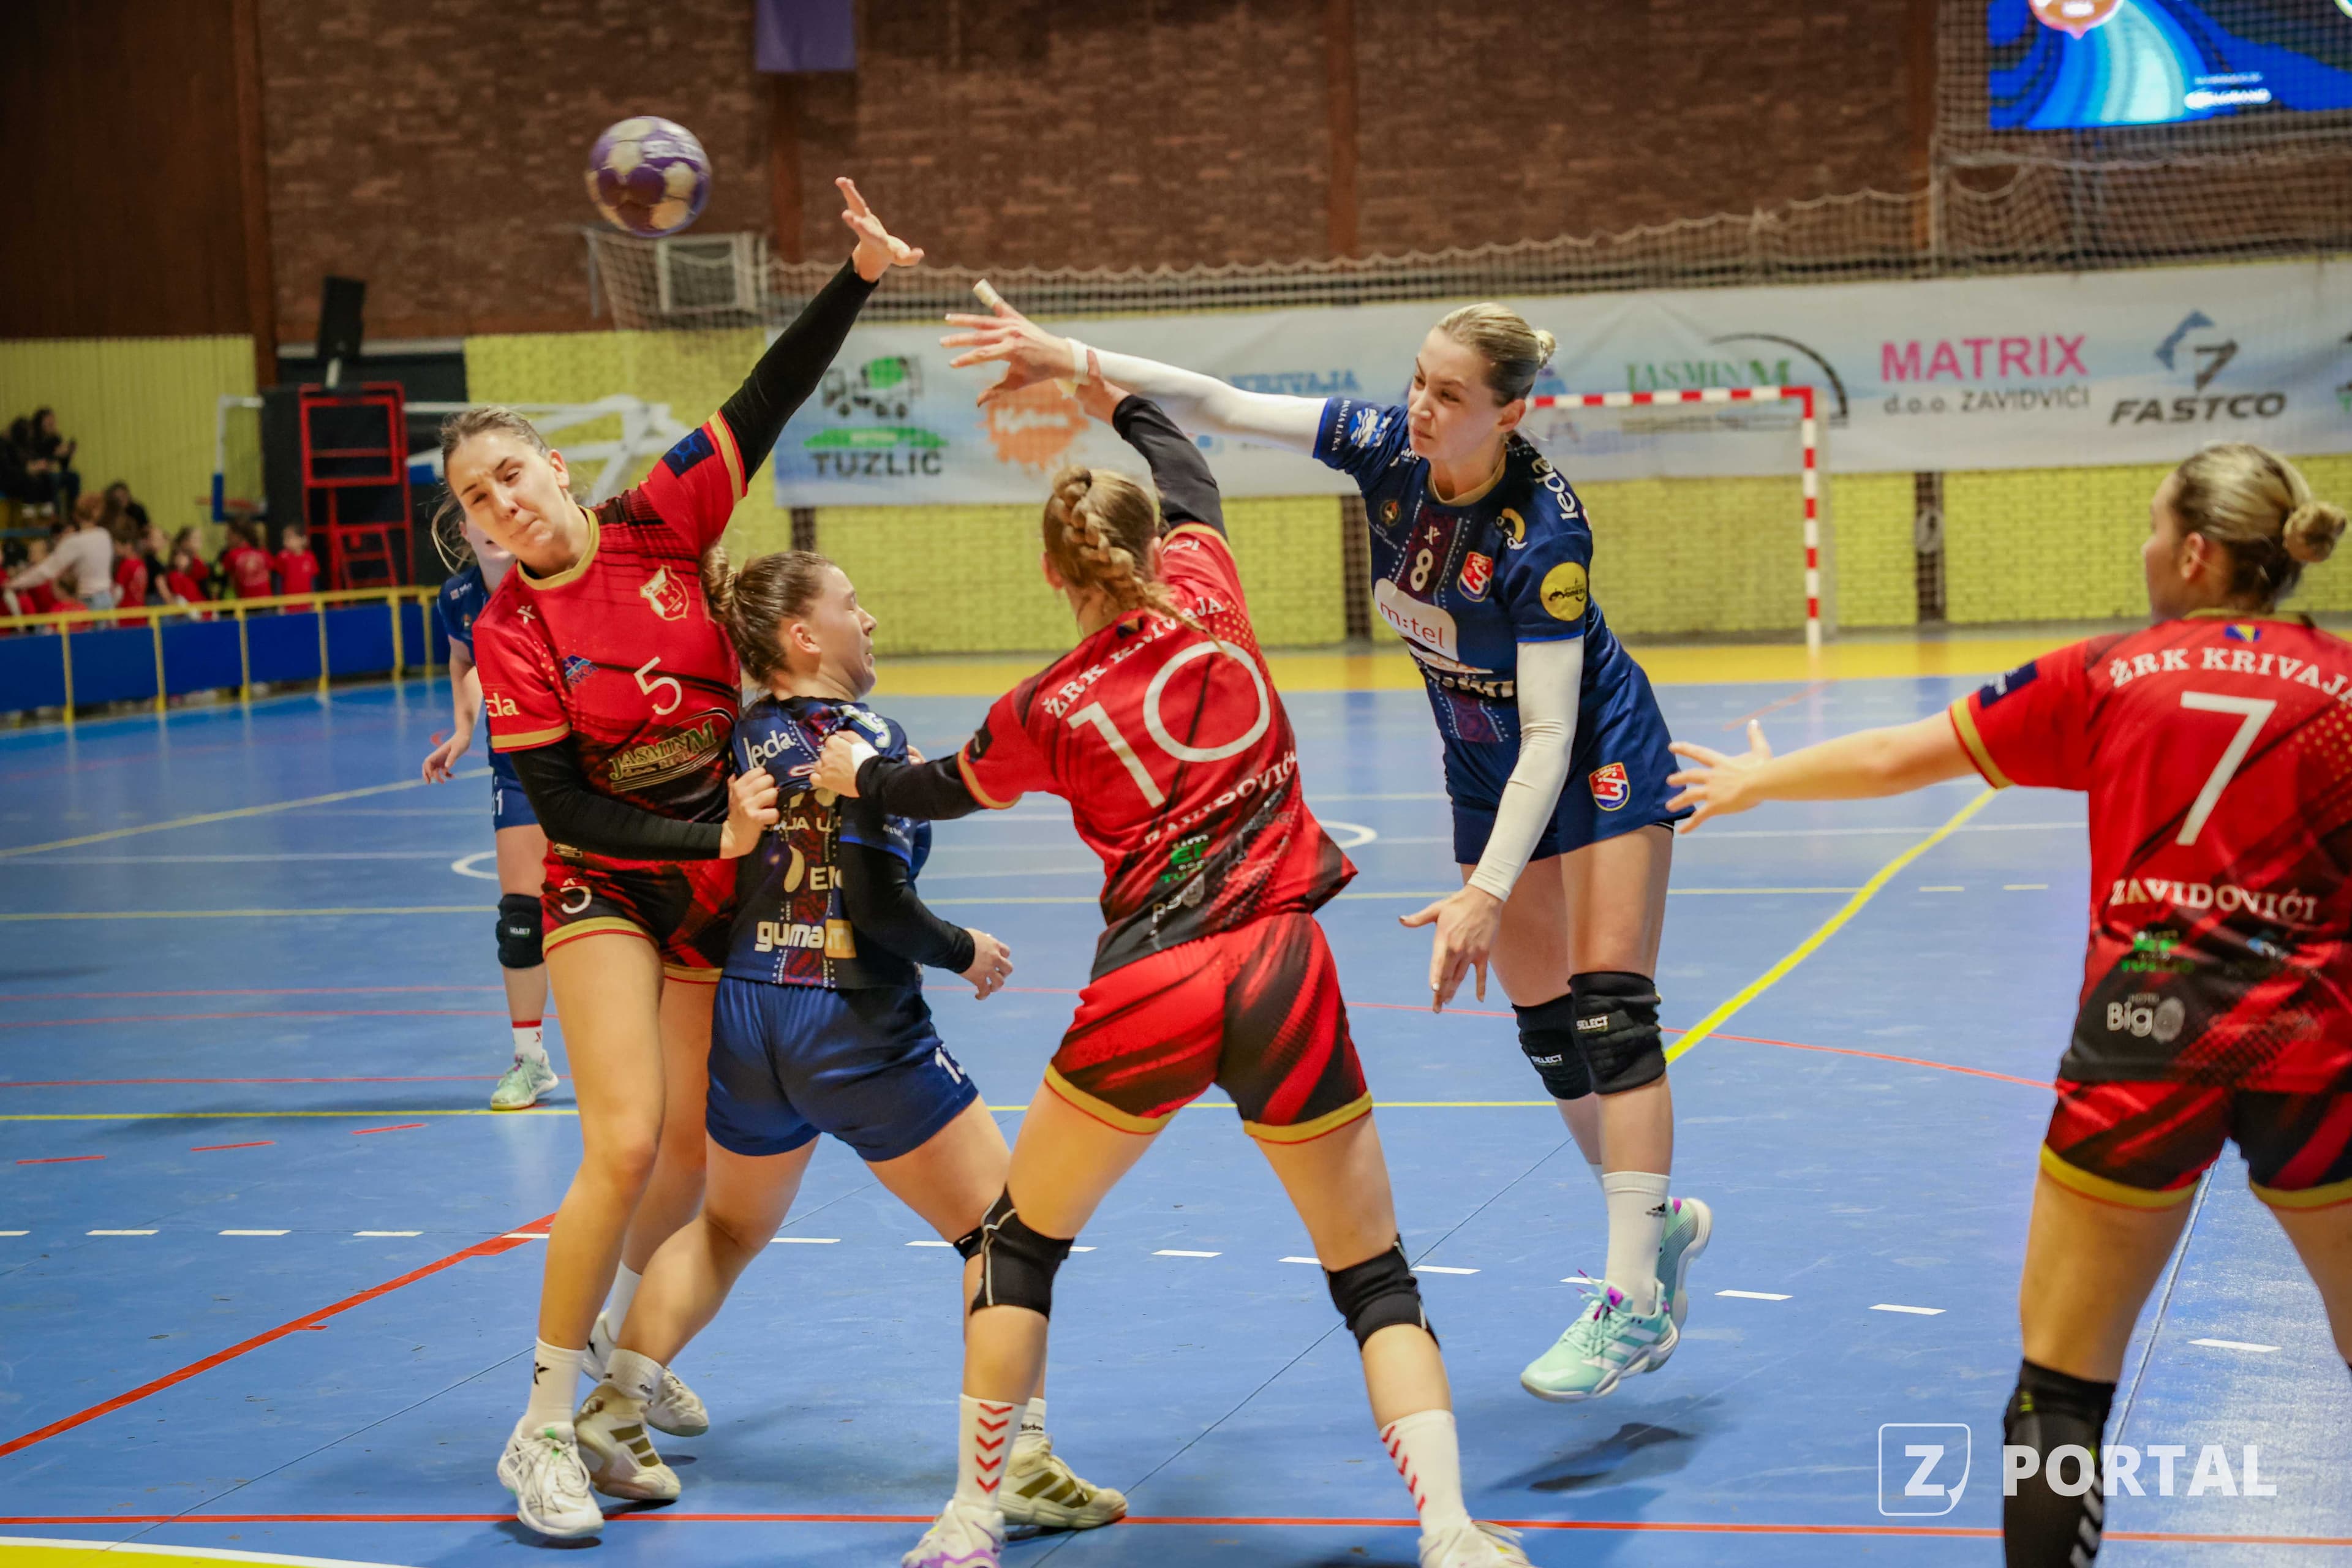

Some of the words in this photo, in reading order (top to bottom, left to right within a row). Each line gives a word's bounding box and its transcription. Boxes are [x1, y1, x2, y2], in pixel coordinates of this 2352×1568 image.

[1881, 335, 2089, 382] MATRIX
[2110, 393, 2286, 424] FASTCO
[1532, 456, 1578, 520] leda
[1410, 548, 1433, 592] 8
[1380, 602, 1444, 649] m:tel
[633, 657, 682, 715] 5
[2109, 647, 2190, 688] ŽRK
[1042, 663, 1107, 718] ŽRK
[1067, 640, 1271, 809] 10
[743, 729, 796, 770] leda
[2175, 690, 2277, 846] 7
[2109, 878, 2318, 921] ZAVIDOVIĆI
[1576, 1015, 1608, 1031] SELECT
[2107, 1001, 2153, 1037] Big
[1531, 1054, 1562, 1065] SELECT
